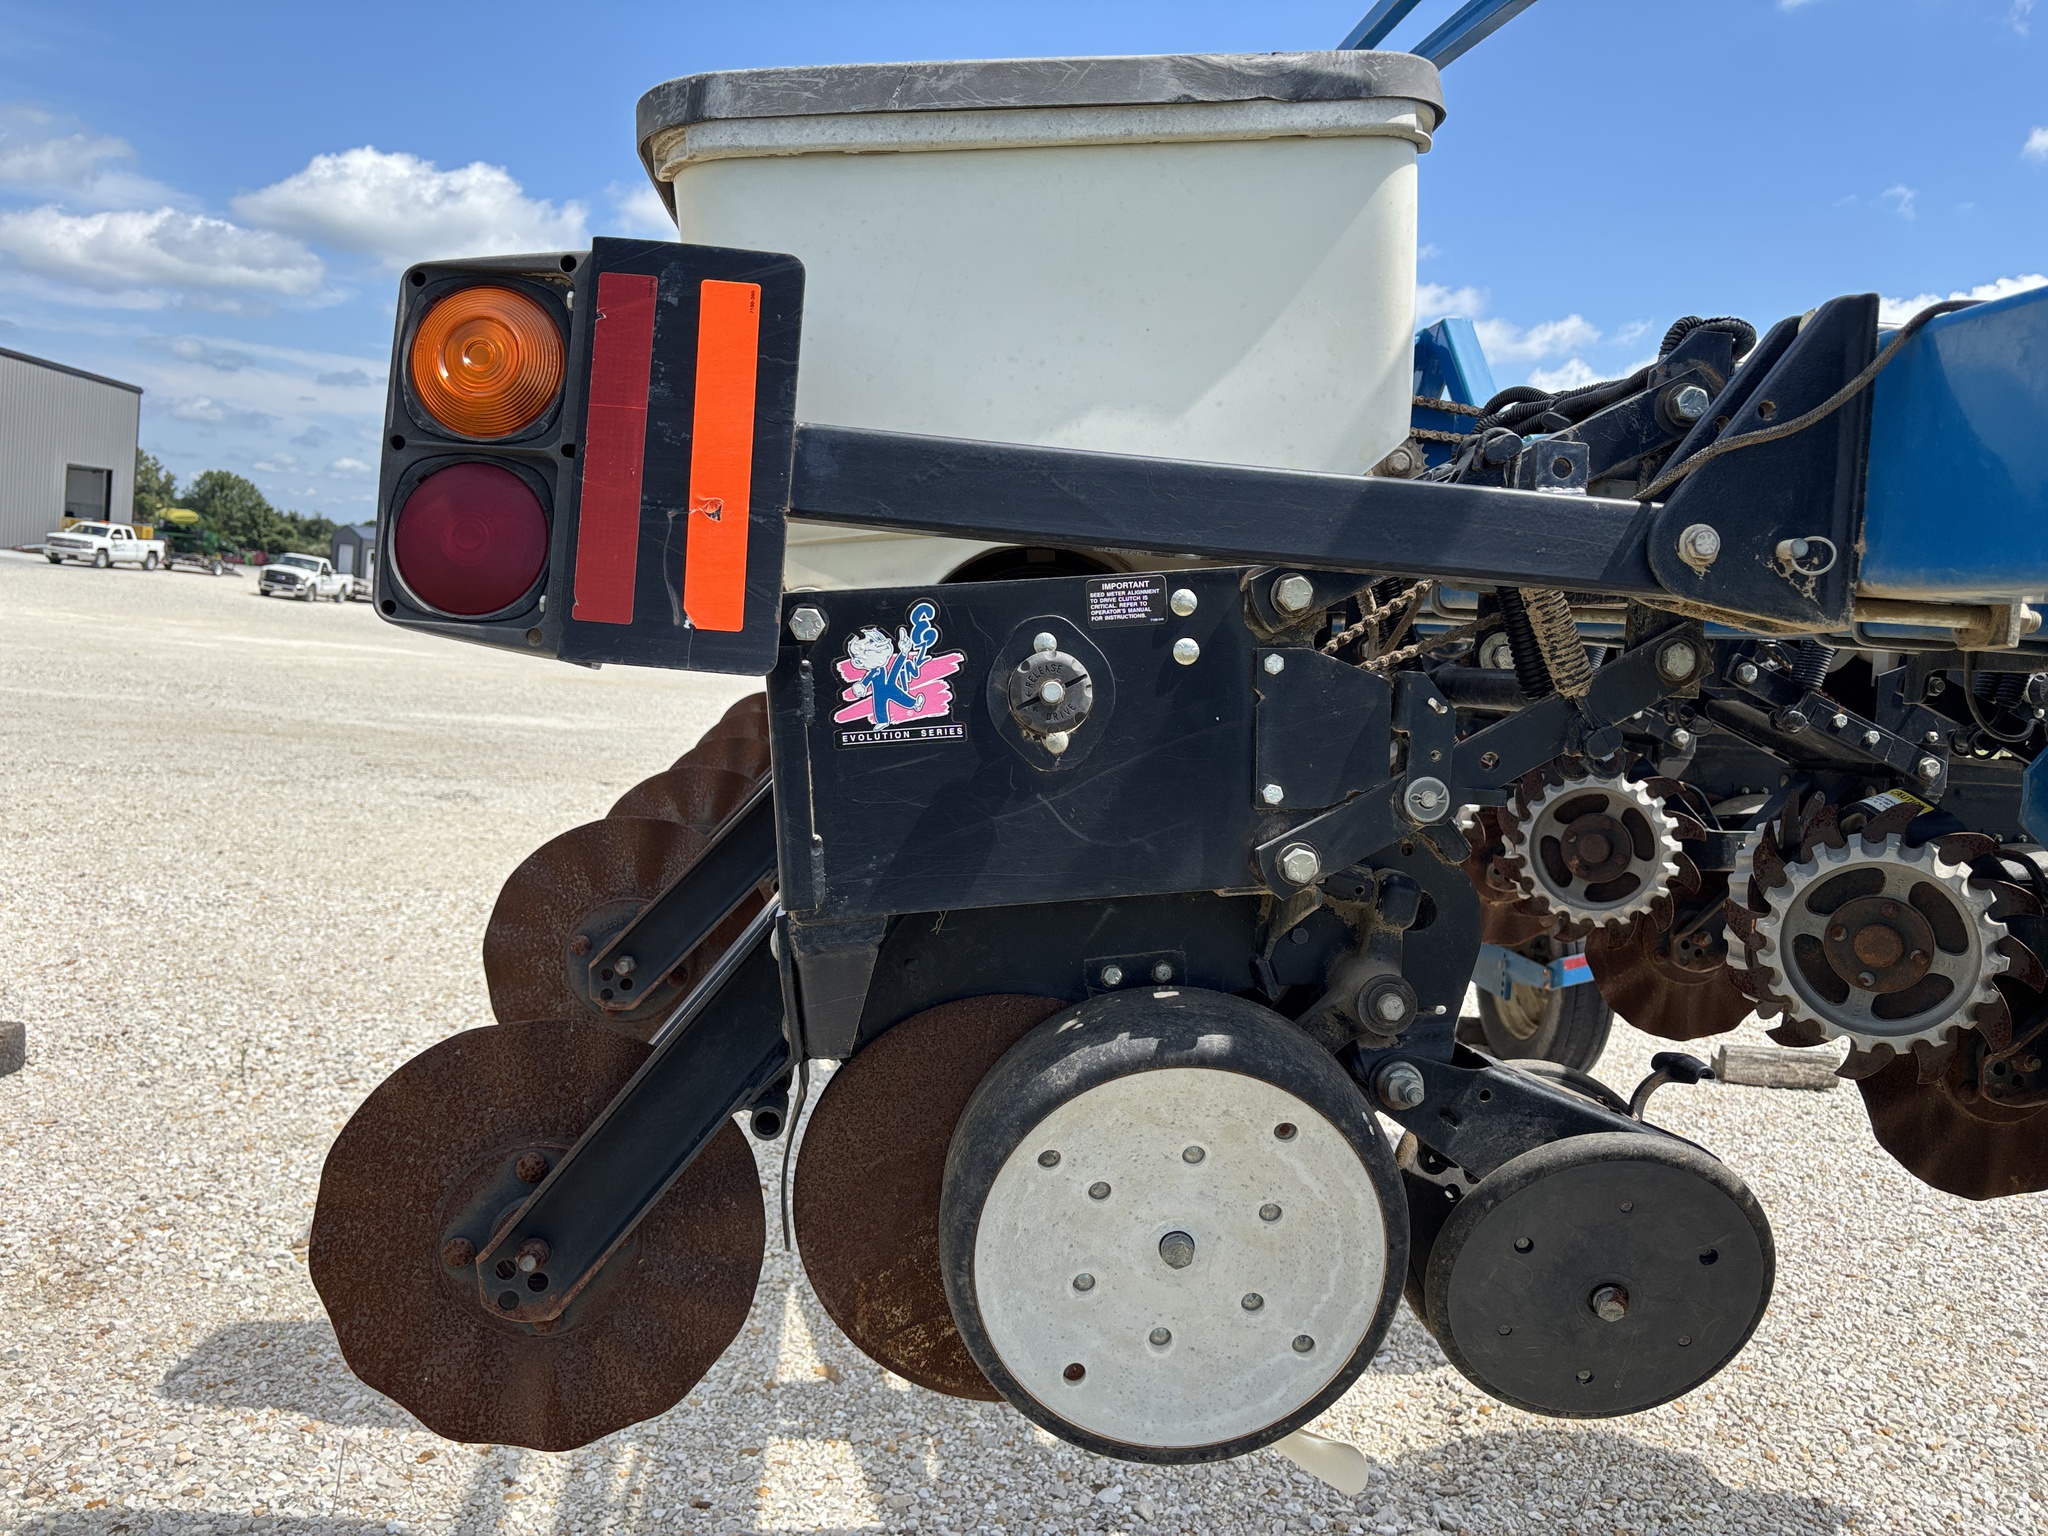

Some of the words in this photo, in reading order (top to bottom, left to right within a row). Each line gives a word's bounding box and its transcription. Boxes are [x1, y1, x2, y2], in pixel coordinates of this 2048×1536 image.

[1102, 581, 1150, 590] IMPORTANT
[1127, 588, 1160, 596] ALIGNMENT
[1090, 608, 1126, 616] OPERATOR'S
[1104, 613, 1147, 621] INSTRUCTIONS.
[1025, 663, 1063, 689] RELEASE
[1046, 703, 1076, 720] DRIVE
[842, 730, 910, 743] EVOLUTION
[920, 727, 963, 738] SERIES
